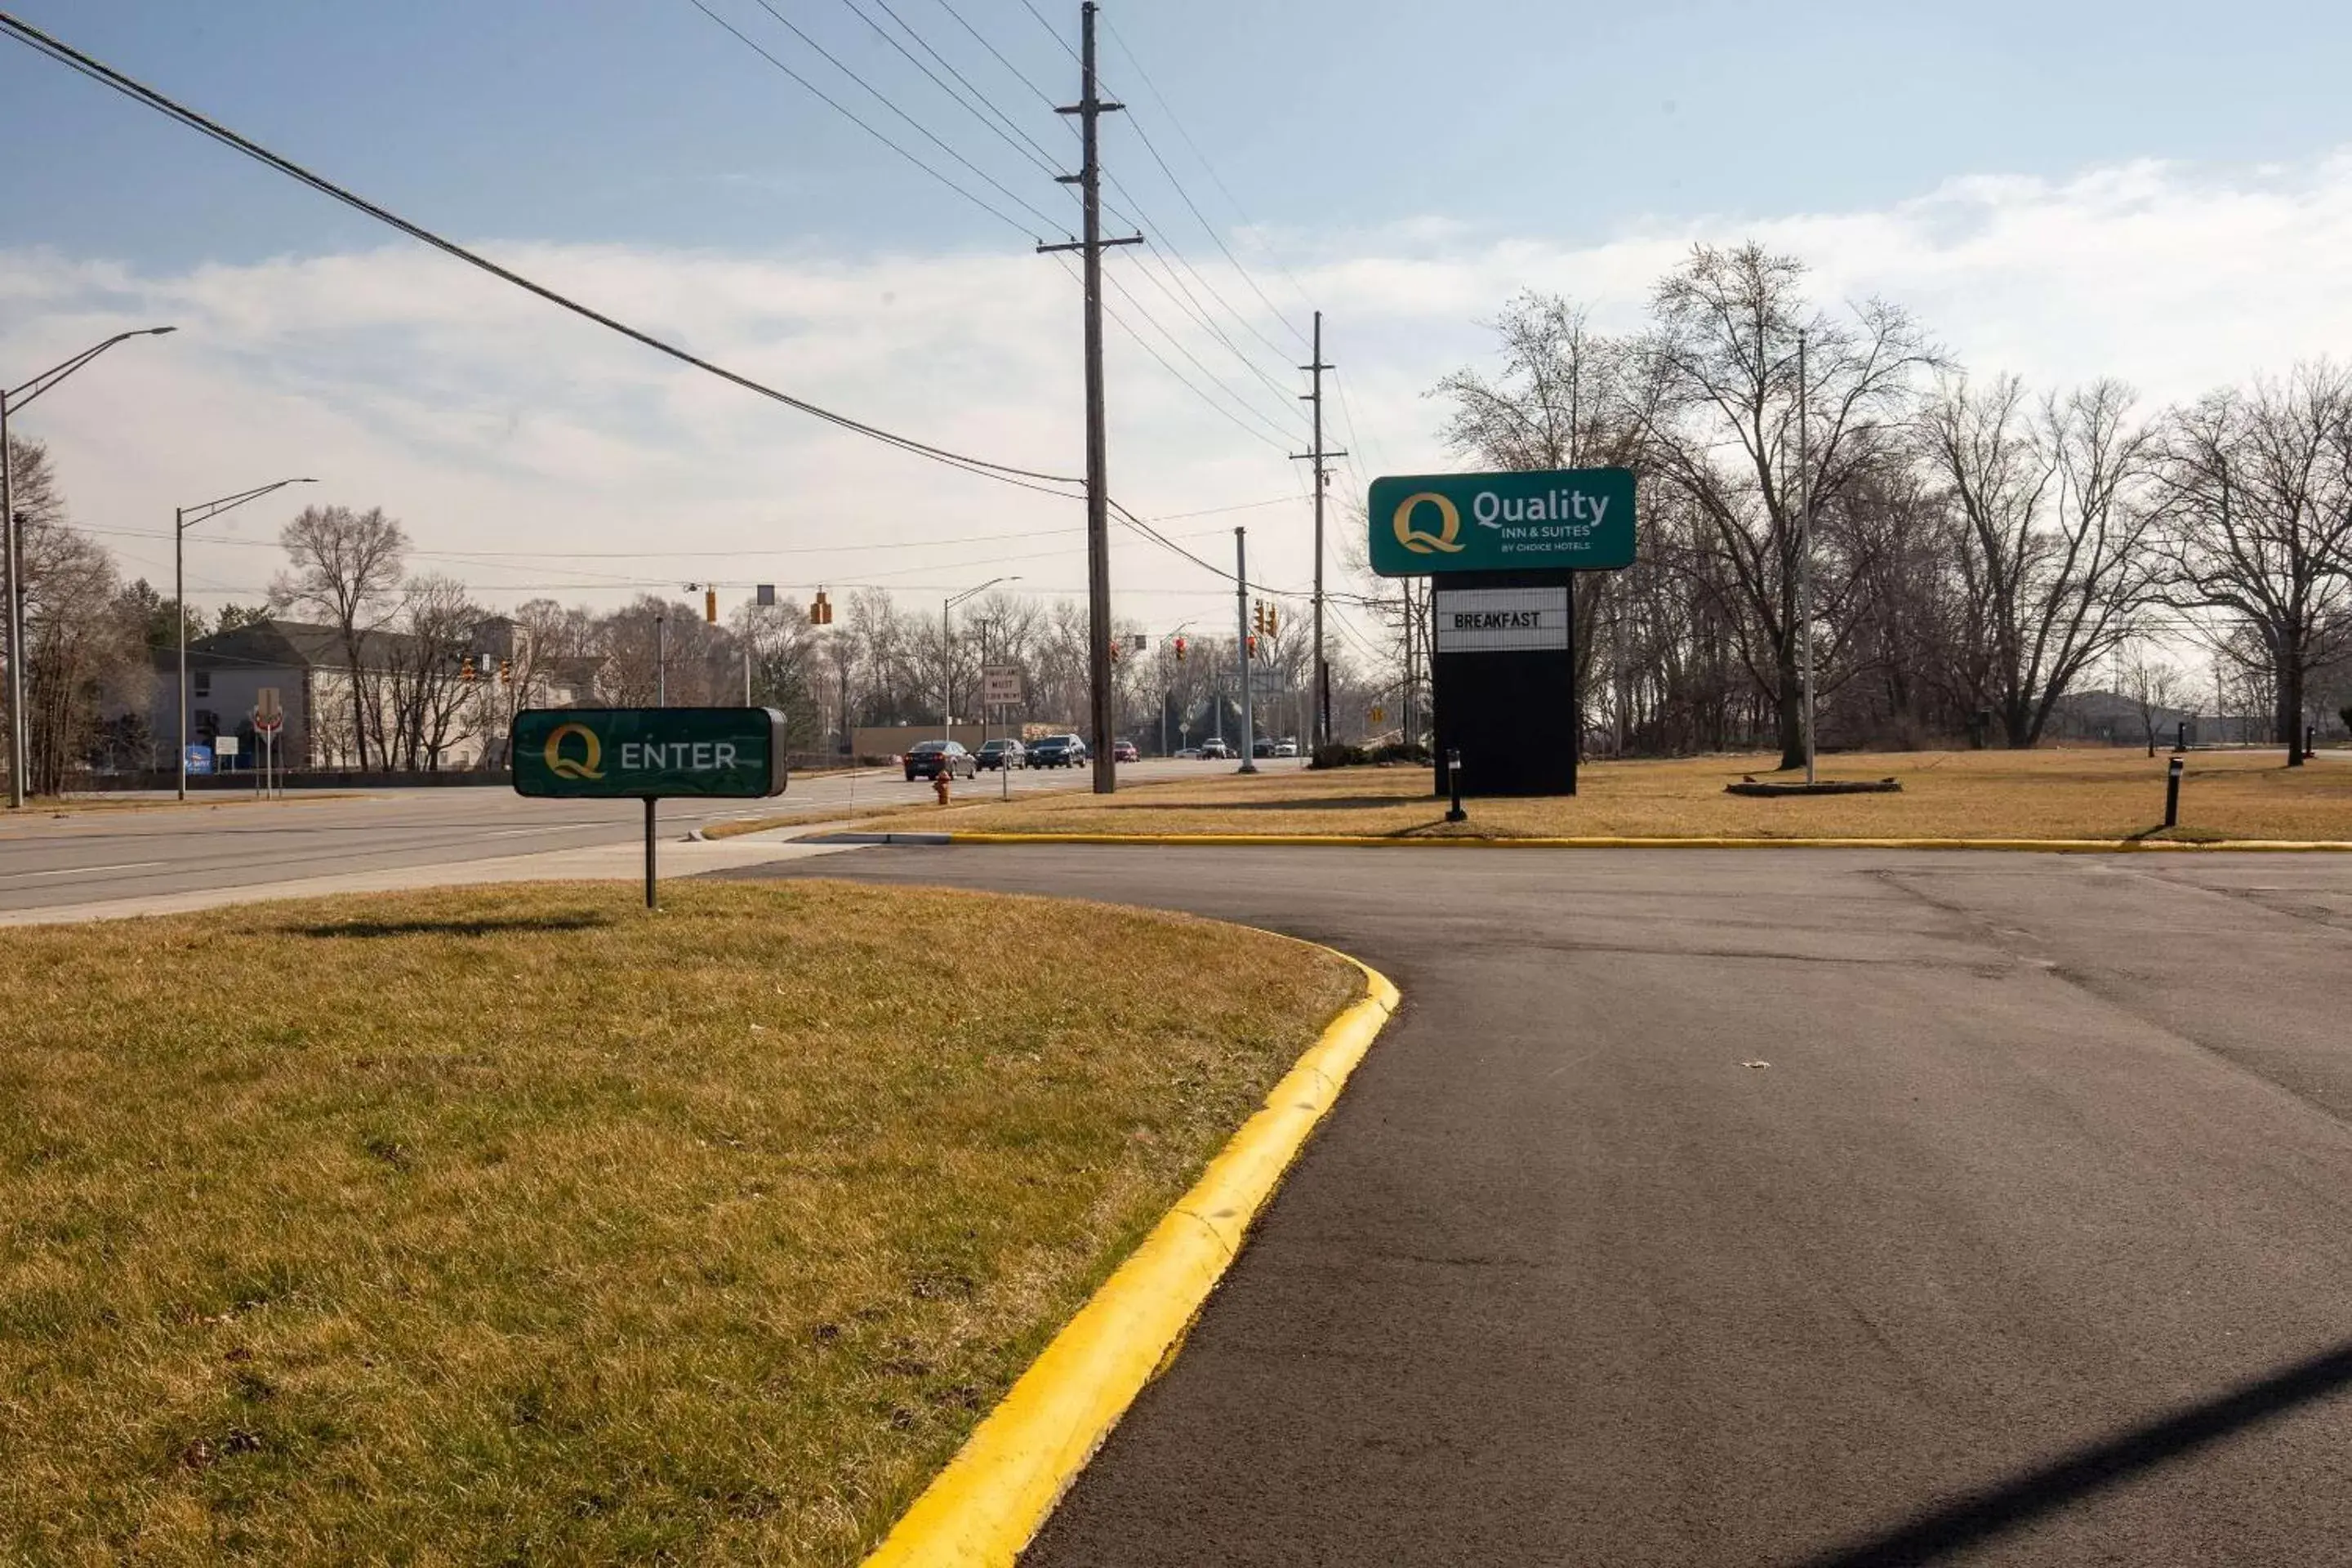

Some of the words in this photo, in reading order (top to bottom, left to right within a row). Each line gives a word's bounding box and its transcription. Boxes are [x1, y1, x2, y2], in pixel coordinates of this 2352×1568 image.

[1393, 492, 1467, 553] Q
[1473, 489, 1610, 529] Quality
[1501, 528, 1526, 539] INN
[1530, 527, 1539, 537] &
[1542, 525, 1591, 537] SUITES
[1501, 545, 1514, 553] BY
[1517, 543, 1552, 552] CHOICE
[1554, 541, 1592, 550] HOTELS
[1454, 612, 1541, 628] BREAKFAST
[545, 723, 608, 779] Q
[621, 742, 737, 770] ENTER
